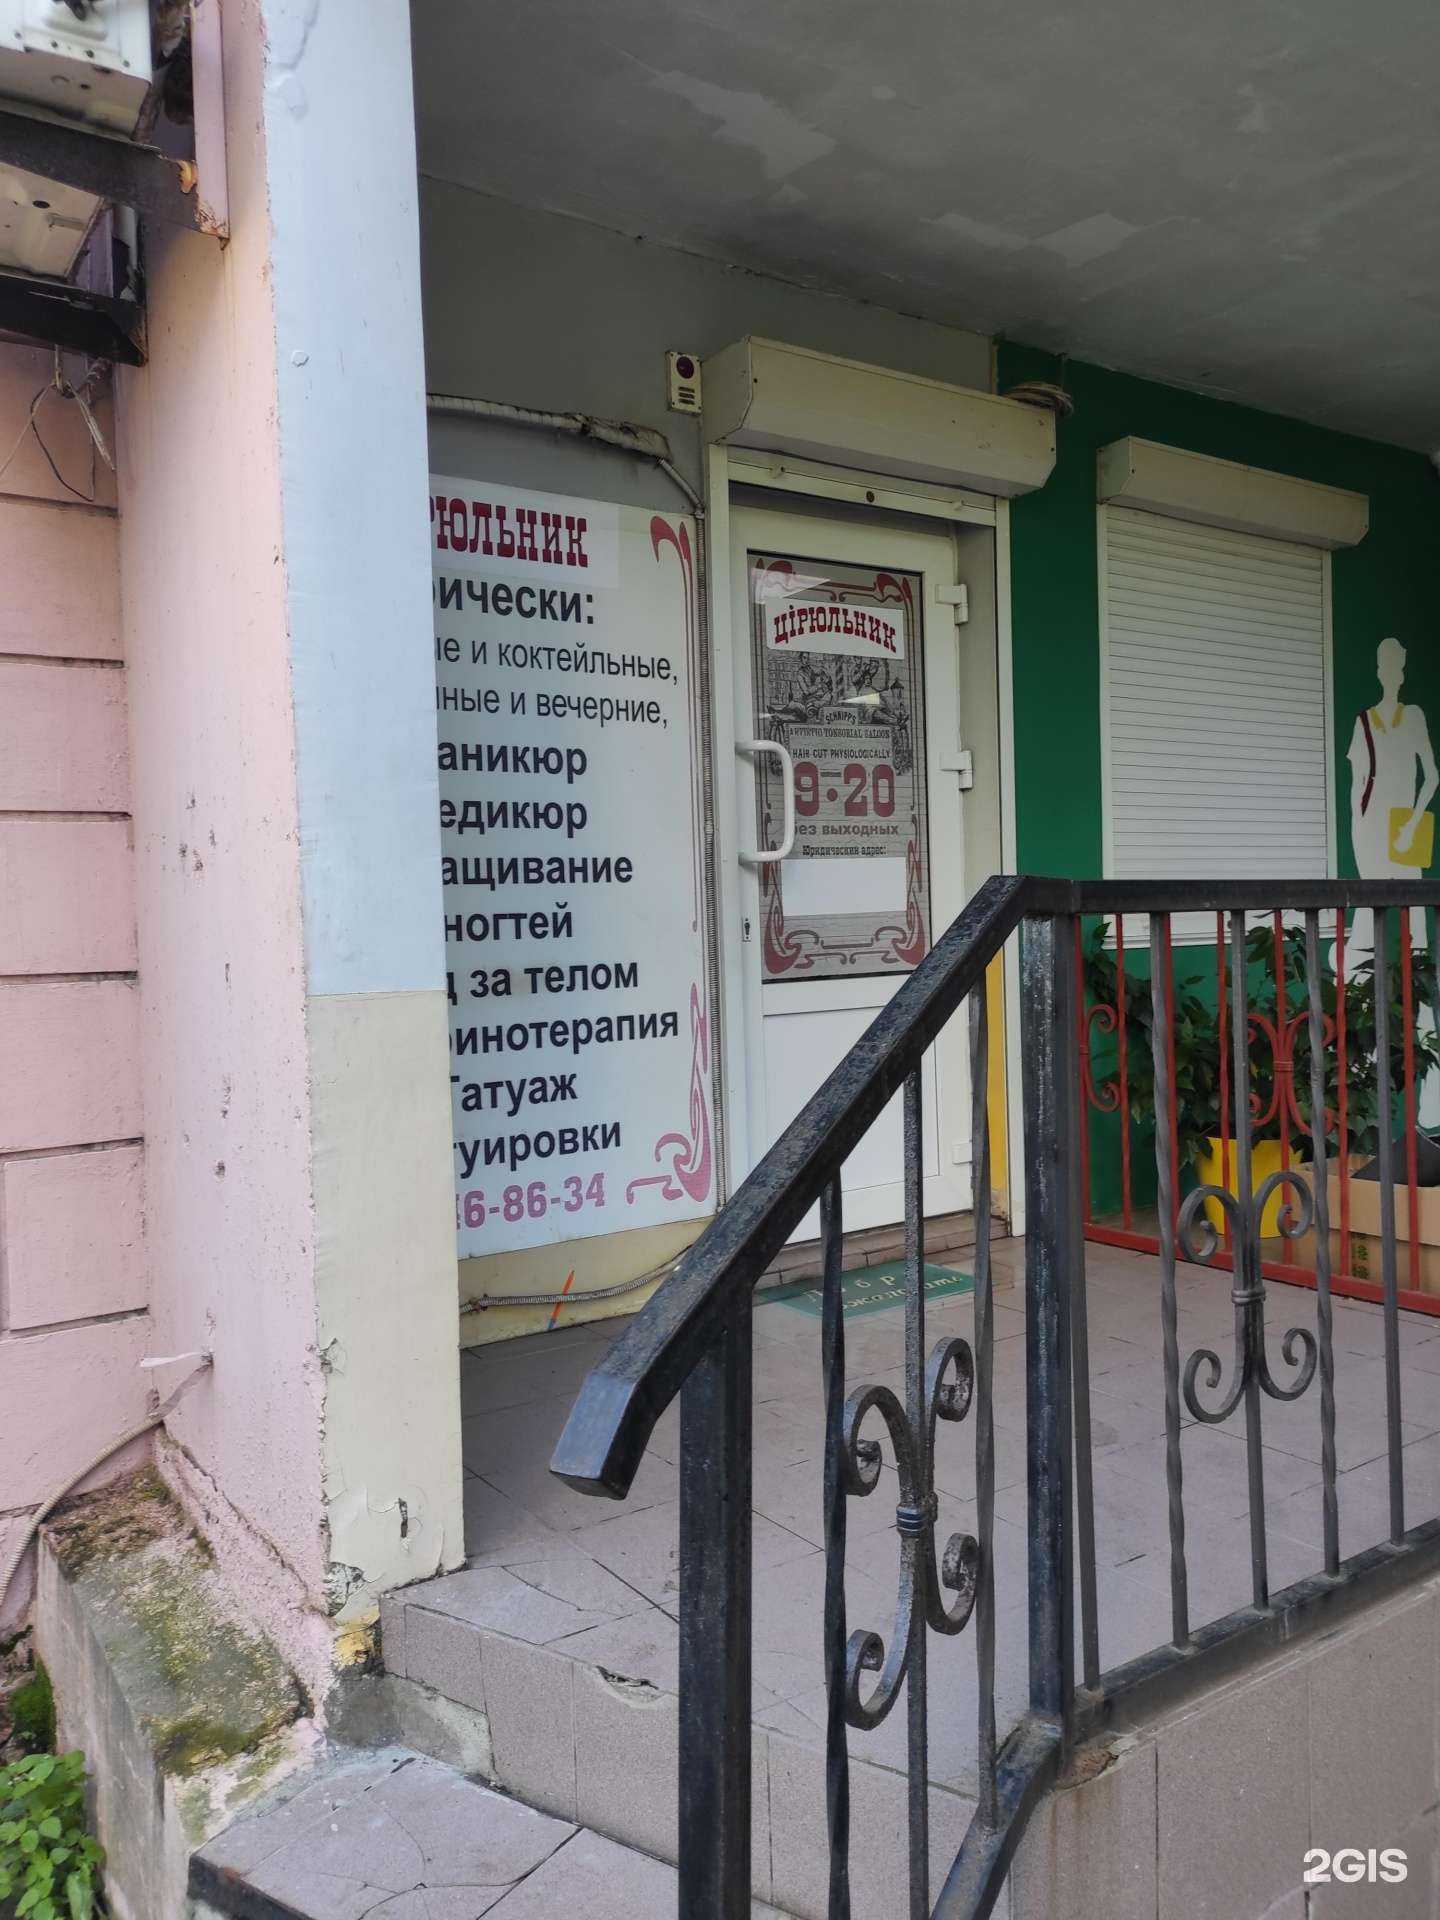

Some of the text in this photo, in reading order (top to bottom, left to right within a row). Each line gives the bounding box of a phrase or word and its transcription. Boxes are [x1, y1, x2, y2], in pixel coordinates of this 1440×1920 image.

[429, 496, 588, 568] ЮЛЬНИК
[432, 576, 594, 624] ически:
[436, 637, 678, 685] е и коктейльные,
[436, 686, 667, 728] ные и вечерние,
[437, 741, 588, 784] аникюр
[440, 798, 588, 838] едикюр
[822, 824, 899, 837] выходных
[441, 854, 633, 891] ащивание
[444, 901, 573, 942] ногтей
[469, 967, 512, 998] за
[523, 962, 638, 994] телом
[449, 1011, 679, 1055] инотерапия
[453, 1122, 621, 1179] уировки
[456, 1172, 605, 1230] 6-86-34
